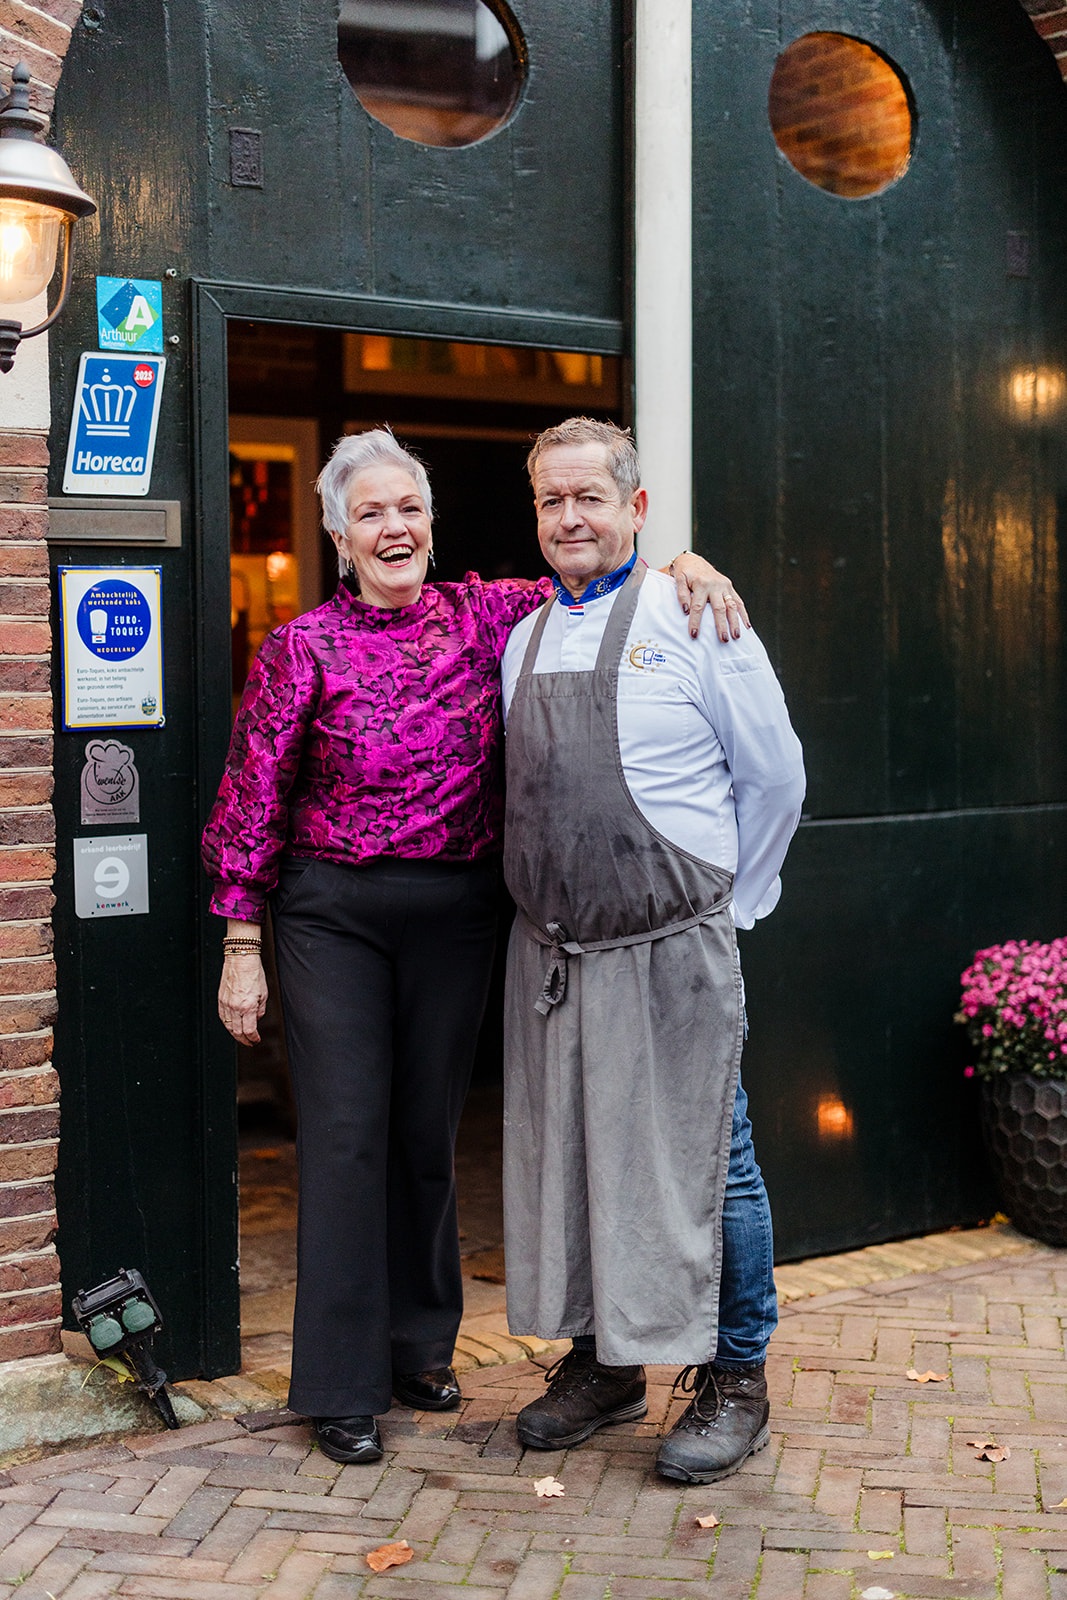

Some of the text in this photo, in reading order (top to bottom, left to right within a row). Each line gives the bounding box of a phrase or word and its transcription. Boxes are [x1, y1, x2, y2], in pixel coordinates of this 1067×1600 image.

[125, 295, 155, 330] A
[101, 327, 138, 342] Arthuur
[134, 370, 153, 381] 2025
[76, 451, 144, 472] Horeca
[90, 591, 138, 599] Ambachtelijk
[114, 615, 141, 625] EURO-
[110, 626, 144, 636] TOQUES
[96, 901, 129, 909] kenwerk
